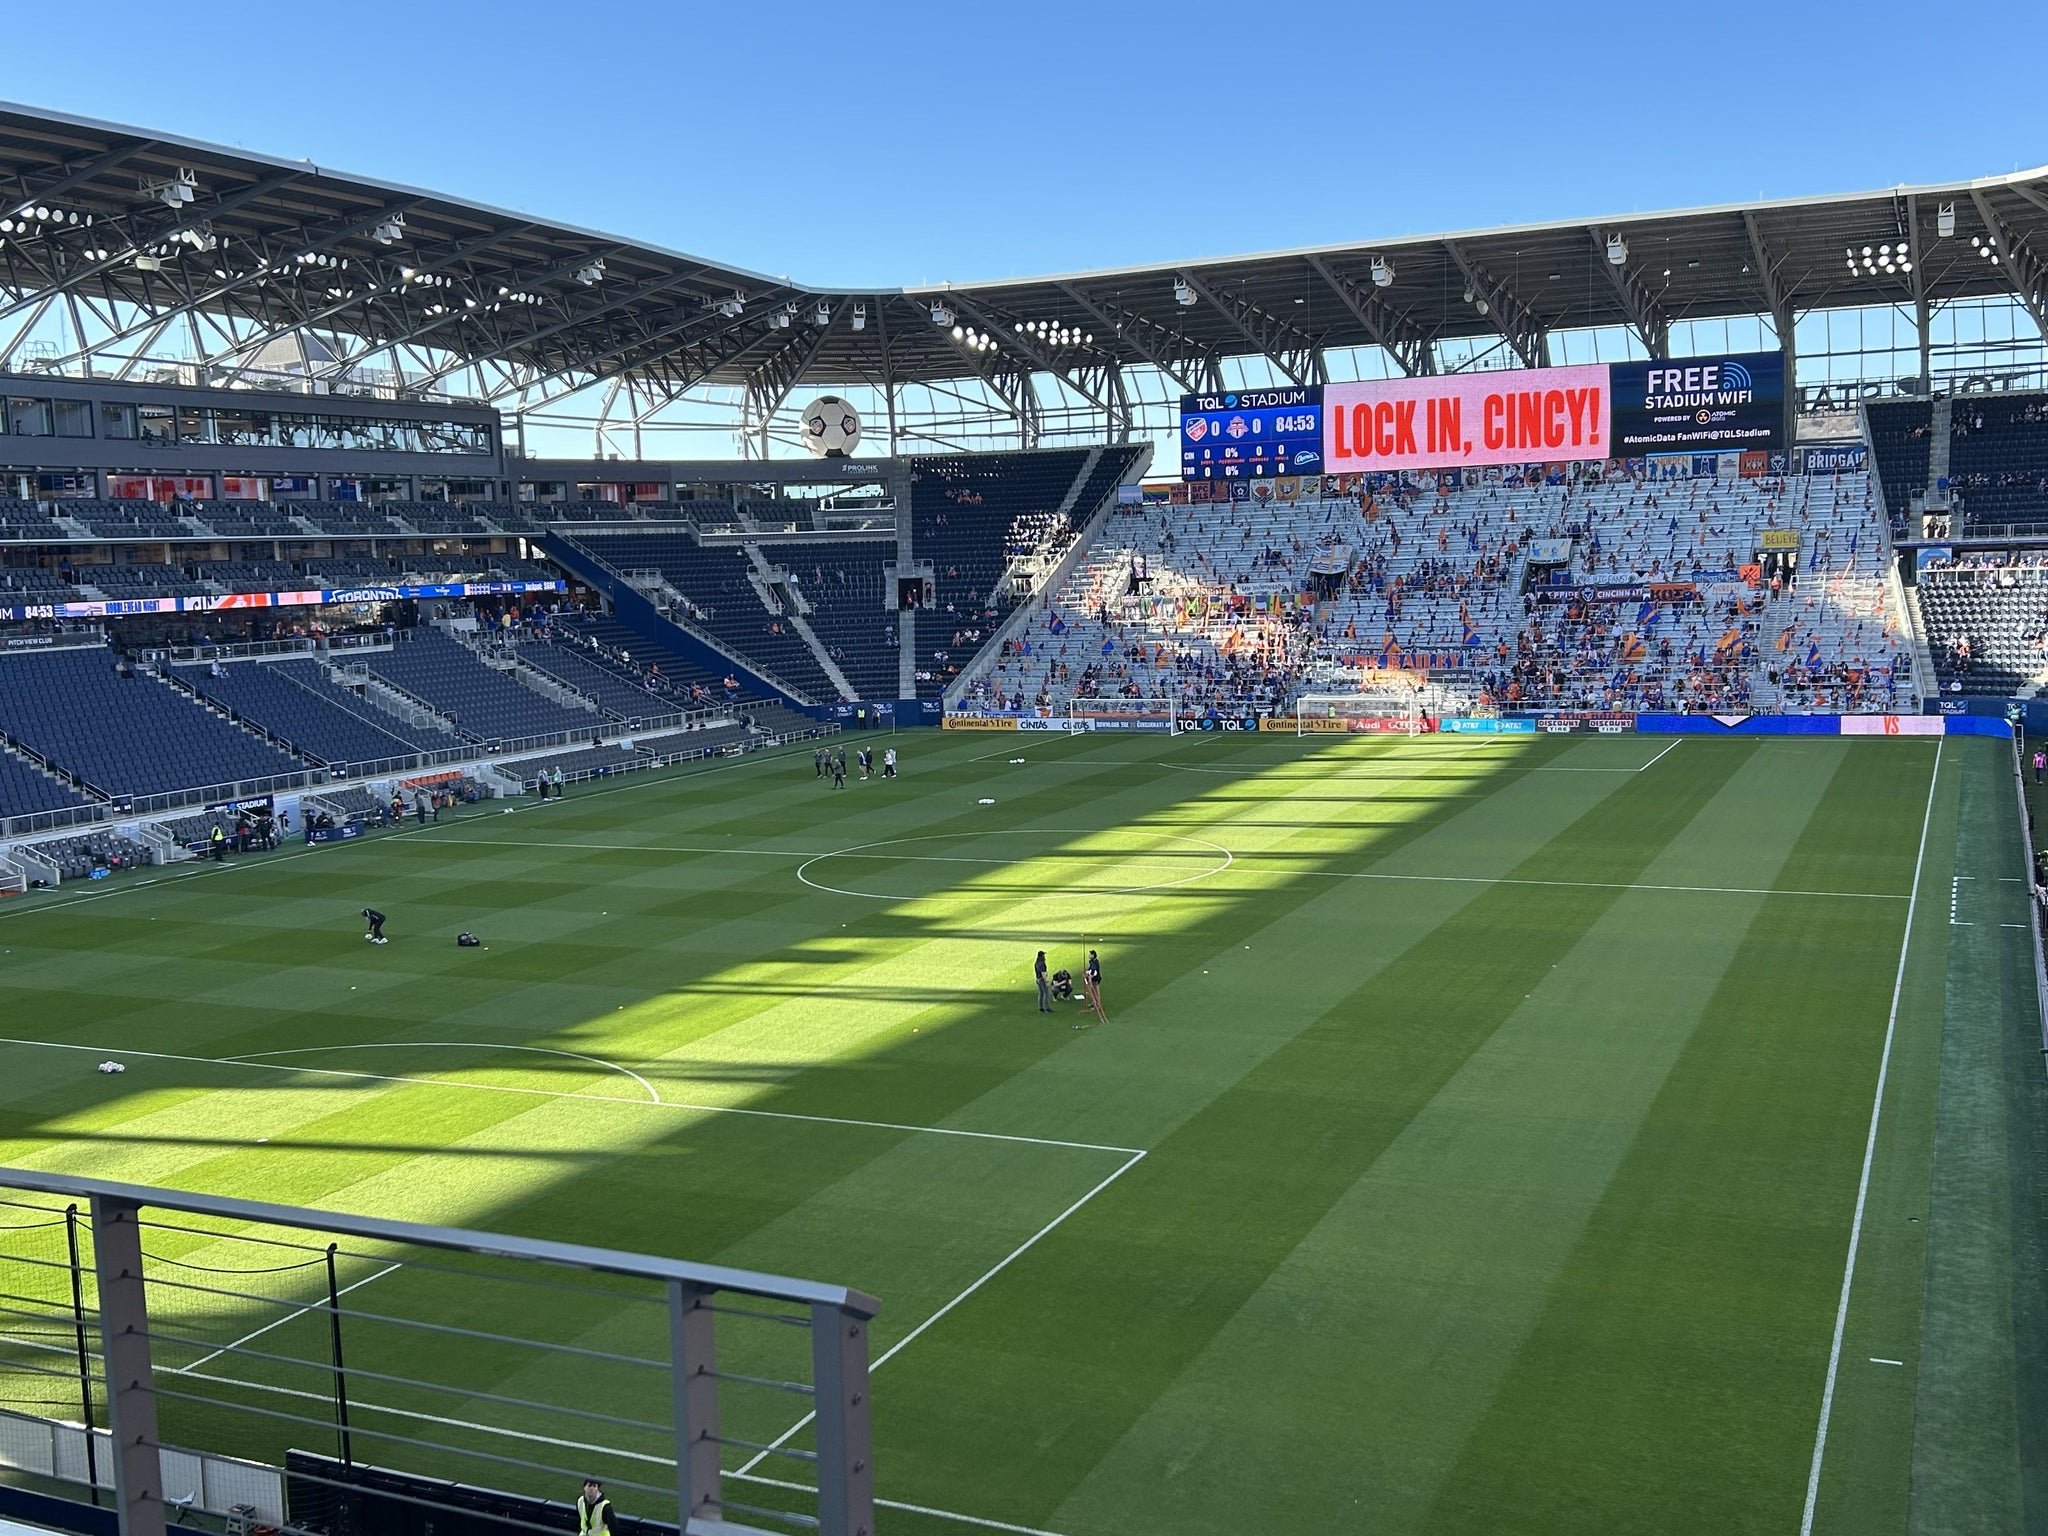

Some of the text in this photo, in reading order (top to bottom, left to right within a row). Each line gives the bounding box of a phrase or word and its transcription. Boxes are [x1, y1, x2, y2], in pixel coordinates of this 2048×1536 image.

[1648, 366, 1719, 394] FREE
[1197, 391, 1305, 410] TQL STADIUM
[1645, 390, 1752, 410] STADIUM WIFI
[1211, 421, 1220, 436] 0
[1253, 418, 1261, 434] 0
[1276, 415, 1315, 433] 84:53
[1334, 387, 1600, 458] LOCK IN, CINCY!
[1624, 433, 1676, 444] #AtomicData
[1204, 449, 1211, 459] 0
[1225, 447, 1238, 458] 0%
[1256, 446, 1262, 456] 0
[1278, 444, 1284, 455] 0
[1205, 467, 1210, 477] 0
[1225, 465, 1239, 476] 0%
[1256, 464, 1263, 475] 0
[1278, 463, 1285, 473] 0
[1387, 654, 1462, 669] BAILEY
[948, 719, 1012, 728] Continental Tire
[1178, 720, 1202, 731] TQL
[1220, 720, 1244, 731] TQL
[1322, 721, 1341, 729] Tire
[1356, 721, 1380, 729] Audi
[1884, 716, 1899, 733] VS
[236, 798, 268, 810] STADIUM
